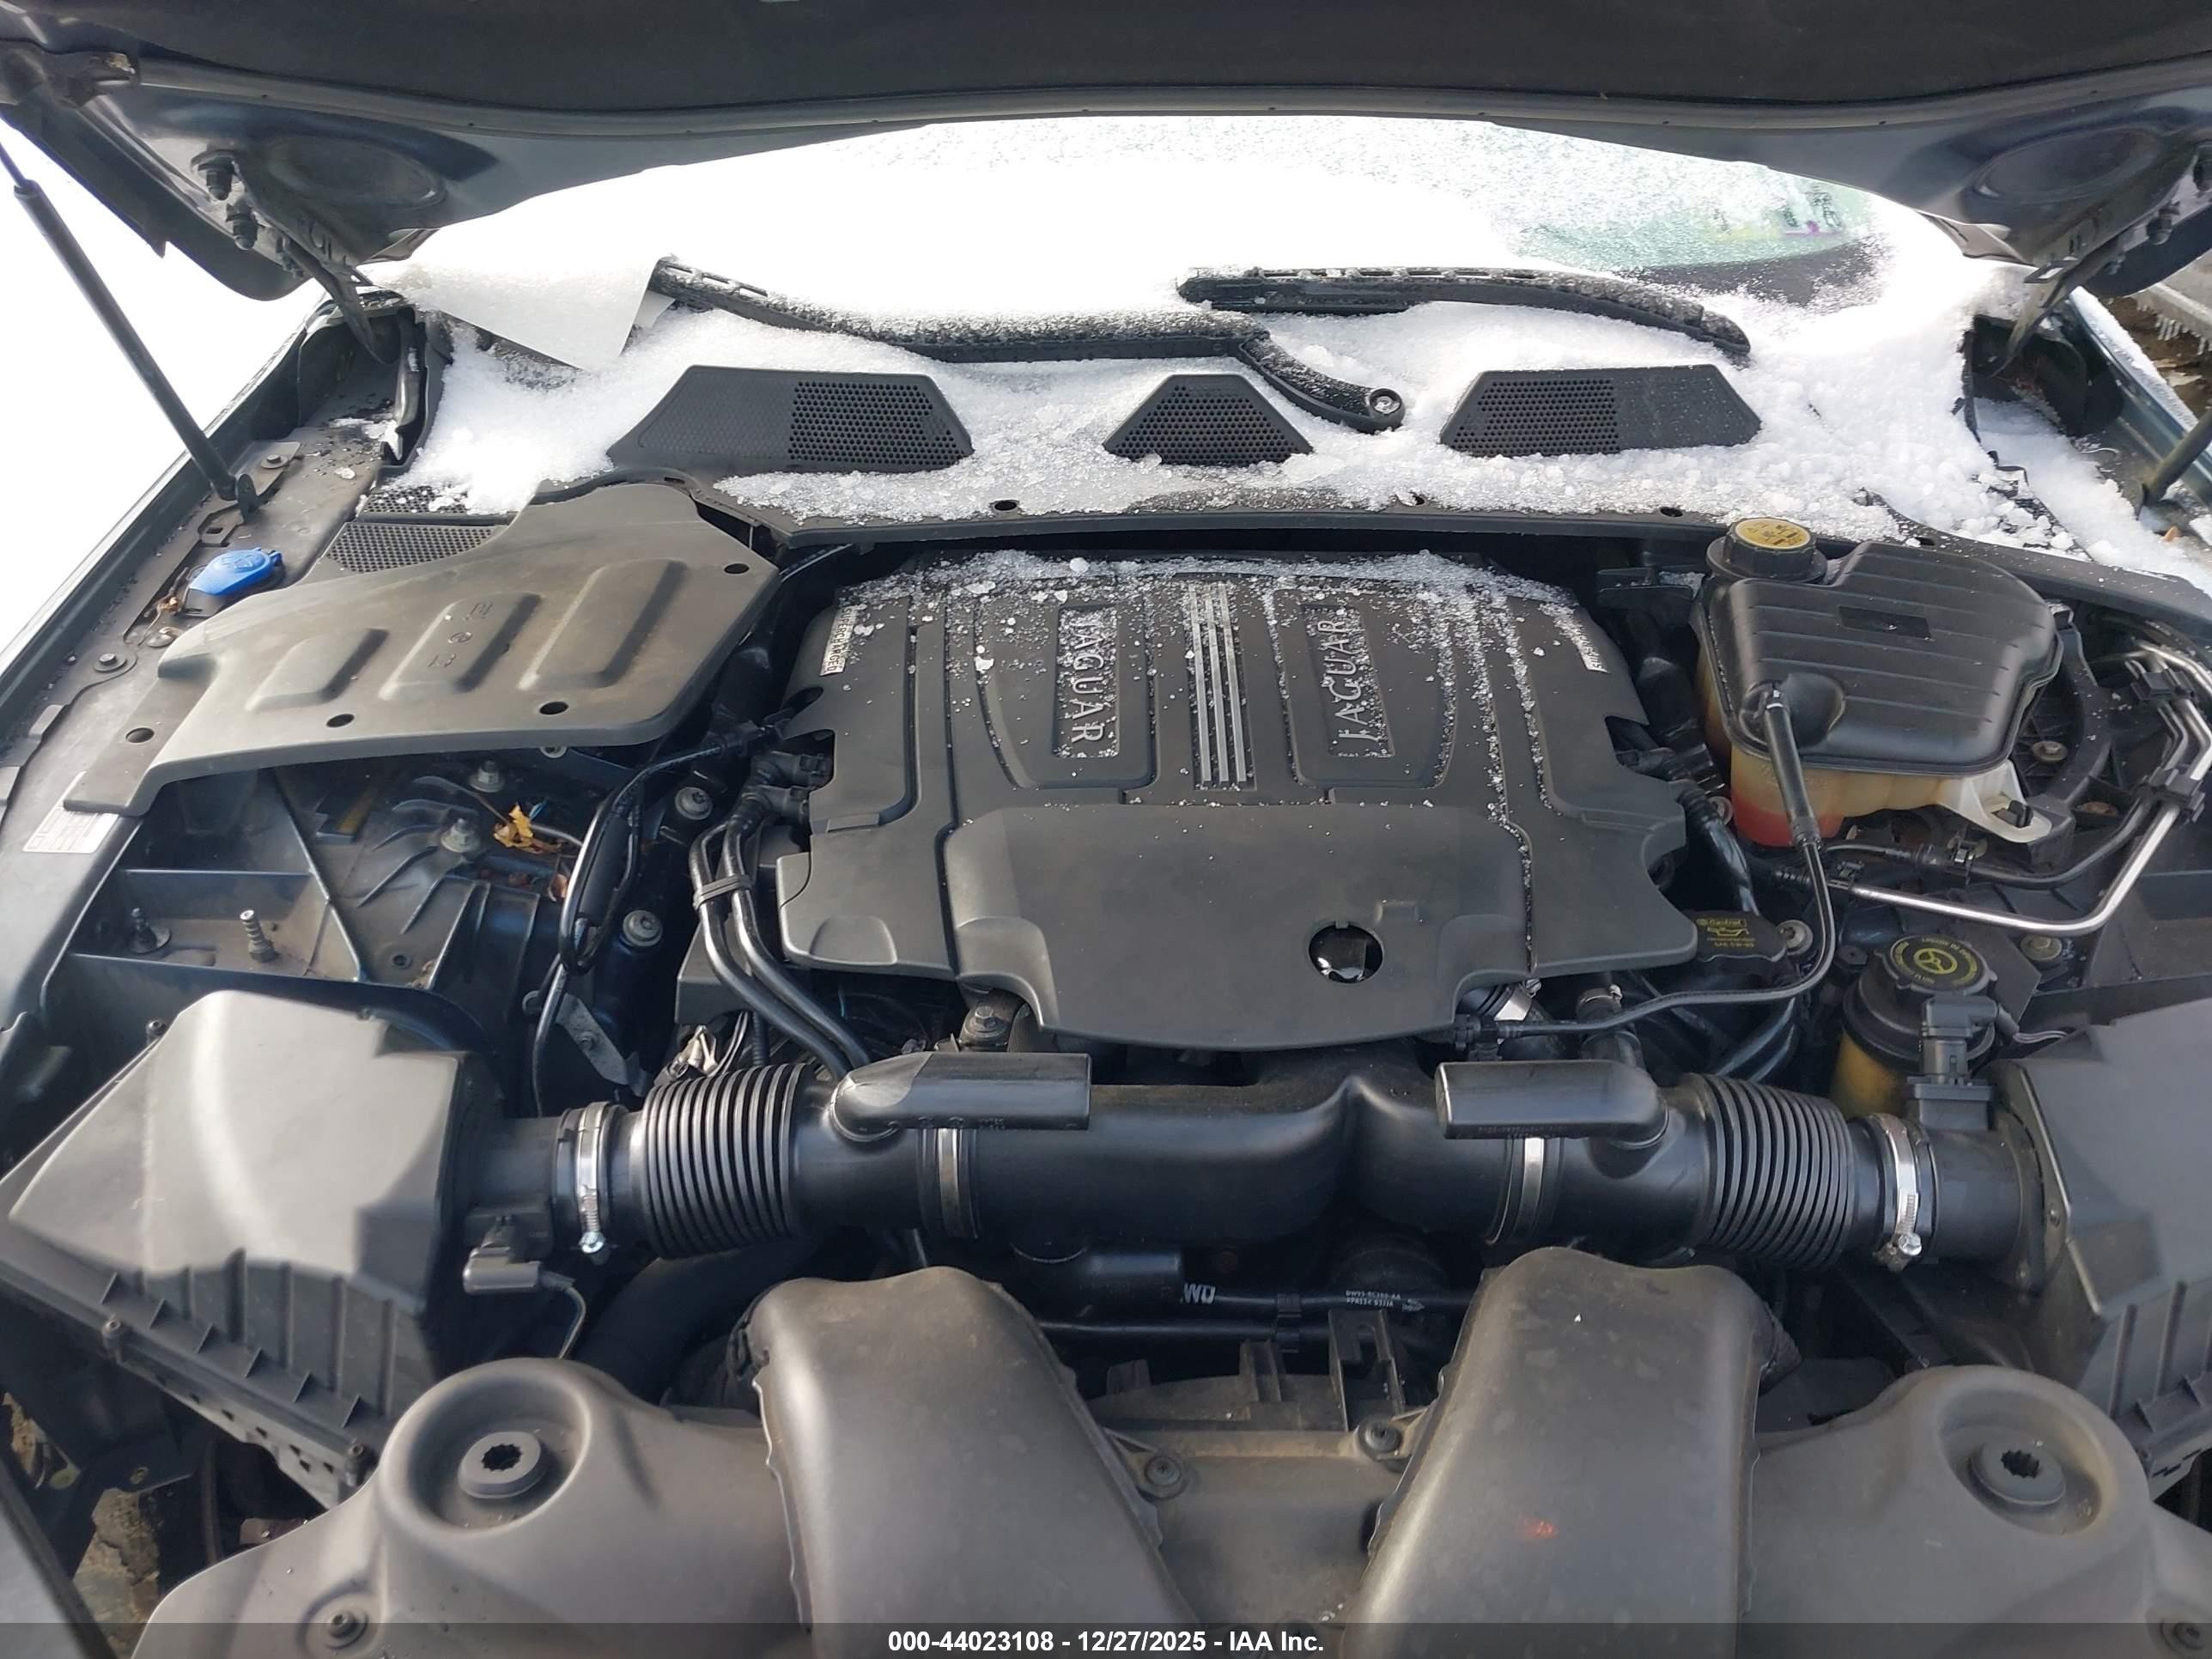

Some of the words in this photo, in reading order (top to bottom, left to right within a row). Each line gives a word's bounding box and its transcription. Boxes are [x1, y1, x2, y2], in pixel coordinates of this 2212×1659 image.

[827, 607, 853, 672] SUPERCHARGED
[1069, 621, 1105, 744] JAGUAR
[1317, 620, 1379, 743] JAGUAR
